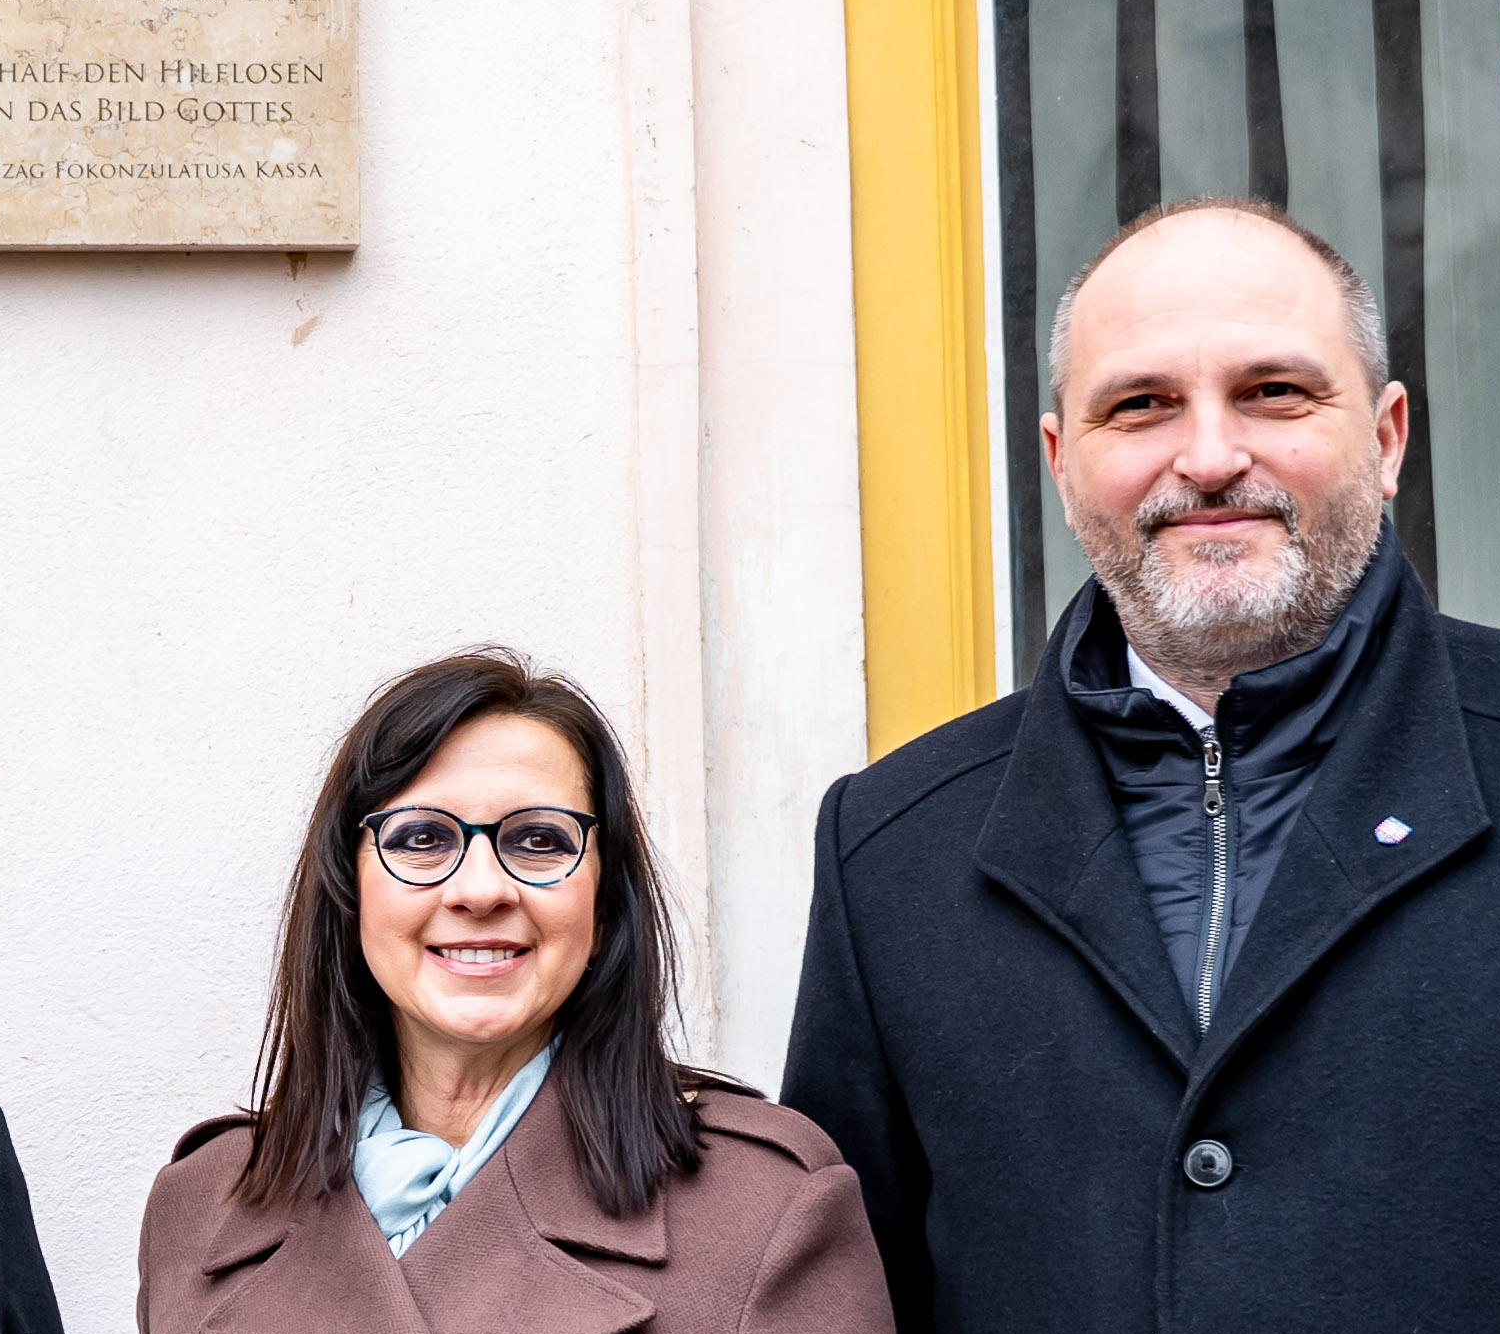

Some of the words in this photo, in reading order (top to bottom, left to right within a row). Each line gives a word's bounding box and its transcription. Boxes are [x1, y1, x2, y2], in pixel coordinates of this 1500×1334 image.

[84, 62, 146, 84] DEN
[160, 59, 325, 85] HILFLOSEN
[28, 100, 83, 122] DAS
[97, 97, 166, 122] BILD
[176, 97, 294, 123] GOTTES
[255, 160, 323, 180] KASSA
